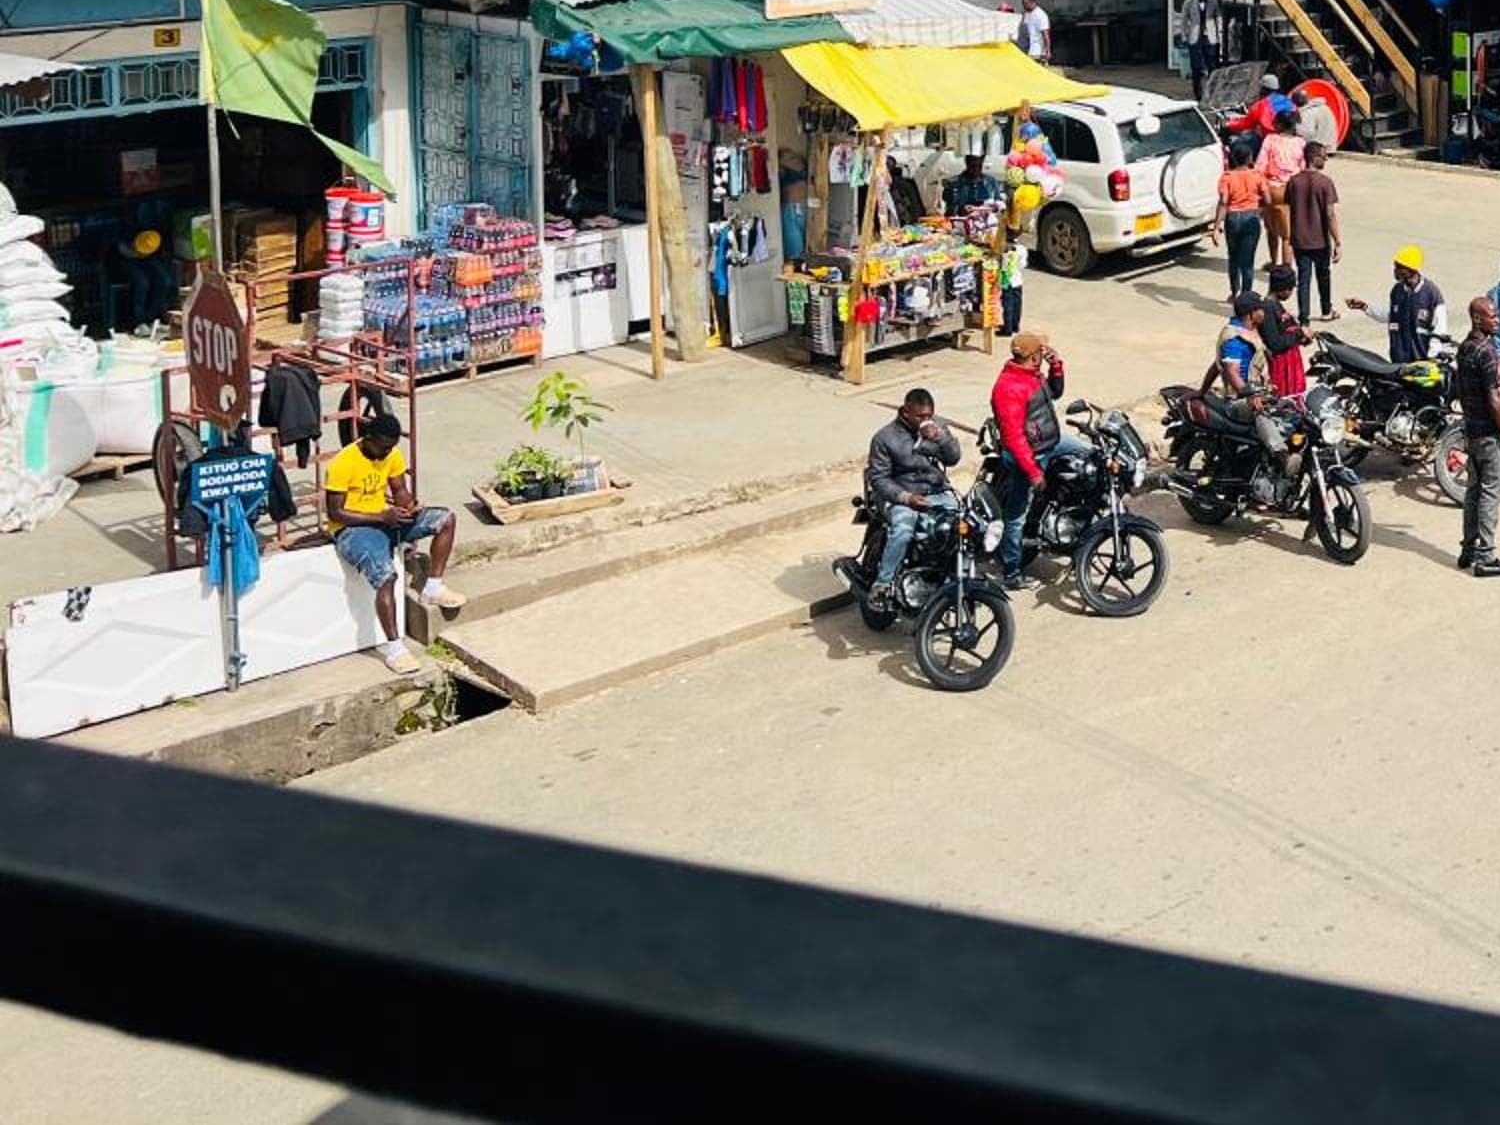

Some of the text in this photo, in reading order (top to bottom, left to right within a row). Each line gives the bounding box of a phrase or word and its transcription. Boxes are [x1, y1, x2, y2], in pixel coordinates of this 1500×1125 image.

[162, 29, 175, 44] 3
[192, 315, 238, 376] STOP
[200, 458, 267, 476] KITUO CHA
[201, 486, 231, 498] KWA
